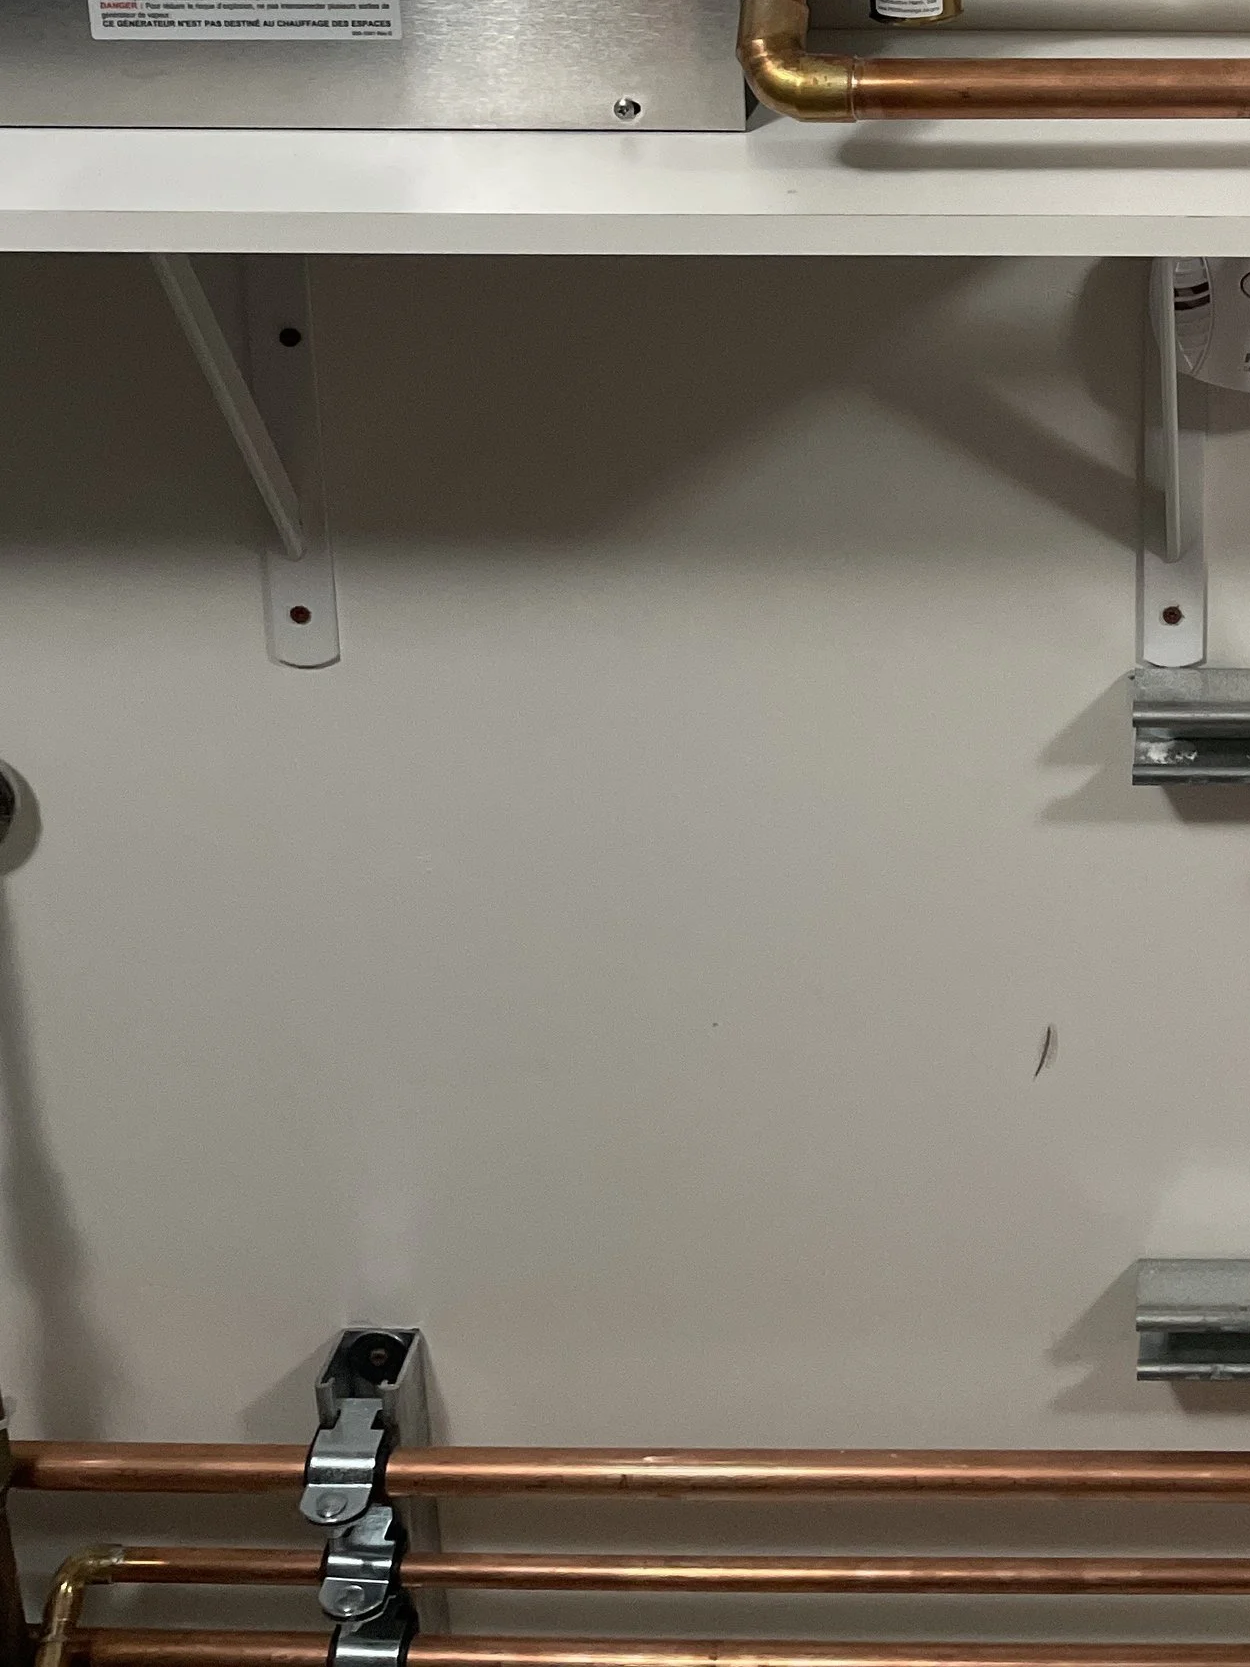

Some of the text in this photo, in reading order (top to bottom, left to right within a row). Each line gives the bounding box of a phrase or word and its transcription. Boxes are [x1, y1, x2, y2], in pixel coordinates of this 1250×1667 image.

[102, 20, 115, 28] CE
[178, 20, 202, 28] N'EST
[205, 20, 222, 28] PAS
[224, 19, 260, 28] DESTINÉ
[263, 20, 275, 28] AU
[277, 20, 330, 28] CHAUFFAGE
[332, 20, 349, 28] DES
[352, 20, 391, 28] ESPACES
